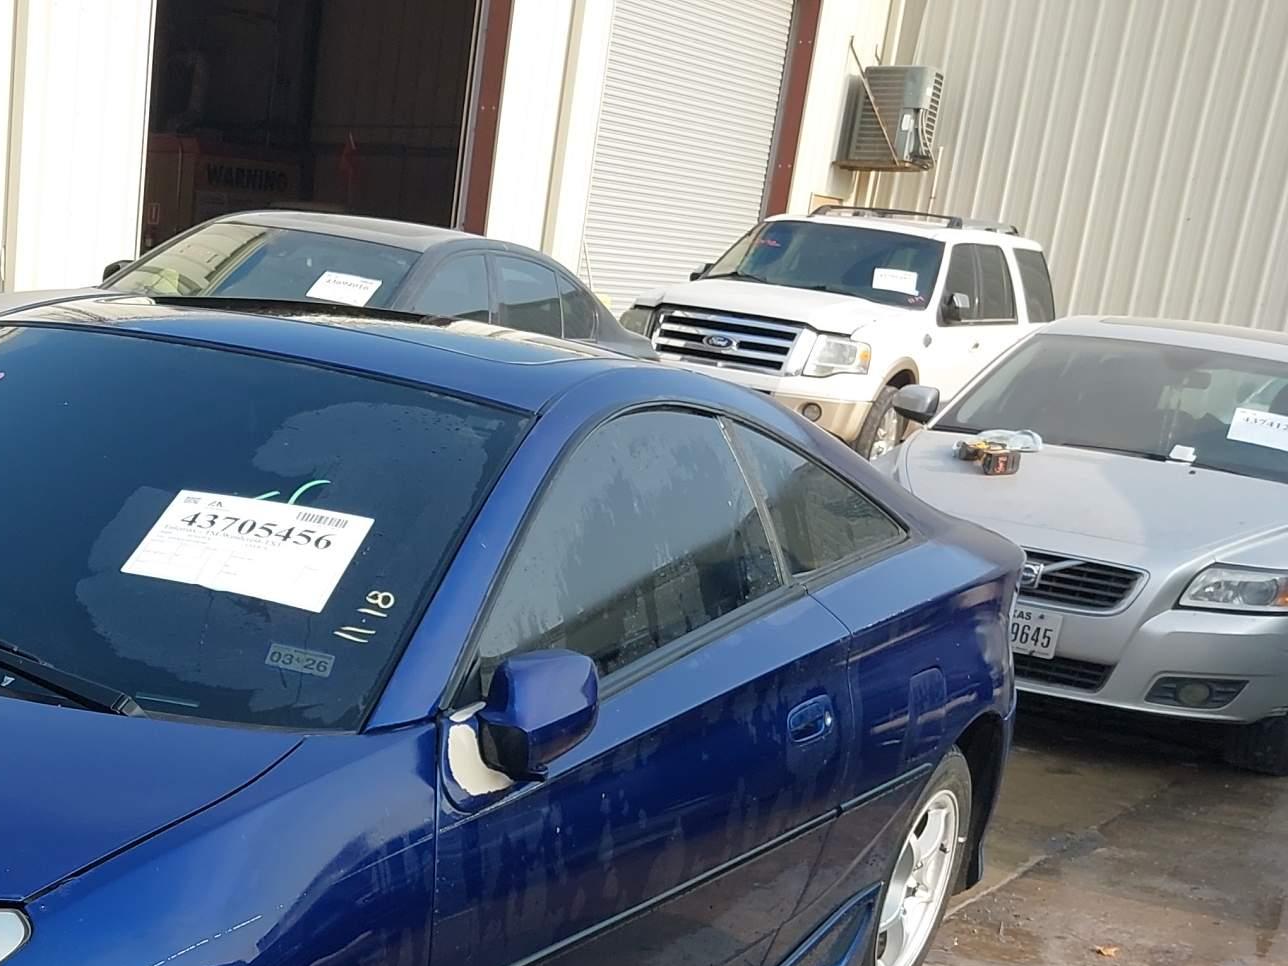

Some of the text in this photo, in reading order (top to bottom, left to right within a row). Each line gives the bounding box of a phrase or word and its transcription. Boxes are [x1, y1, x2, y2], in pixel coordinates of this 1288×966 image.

[180, 511, 337, 550] 43705456
[269, 650, 329, 673] 03 26
